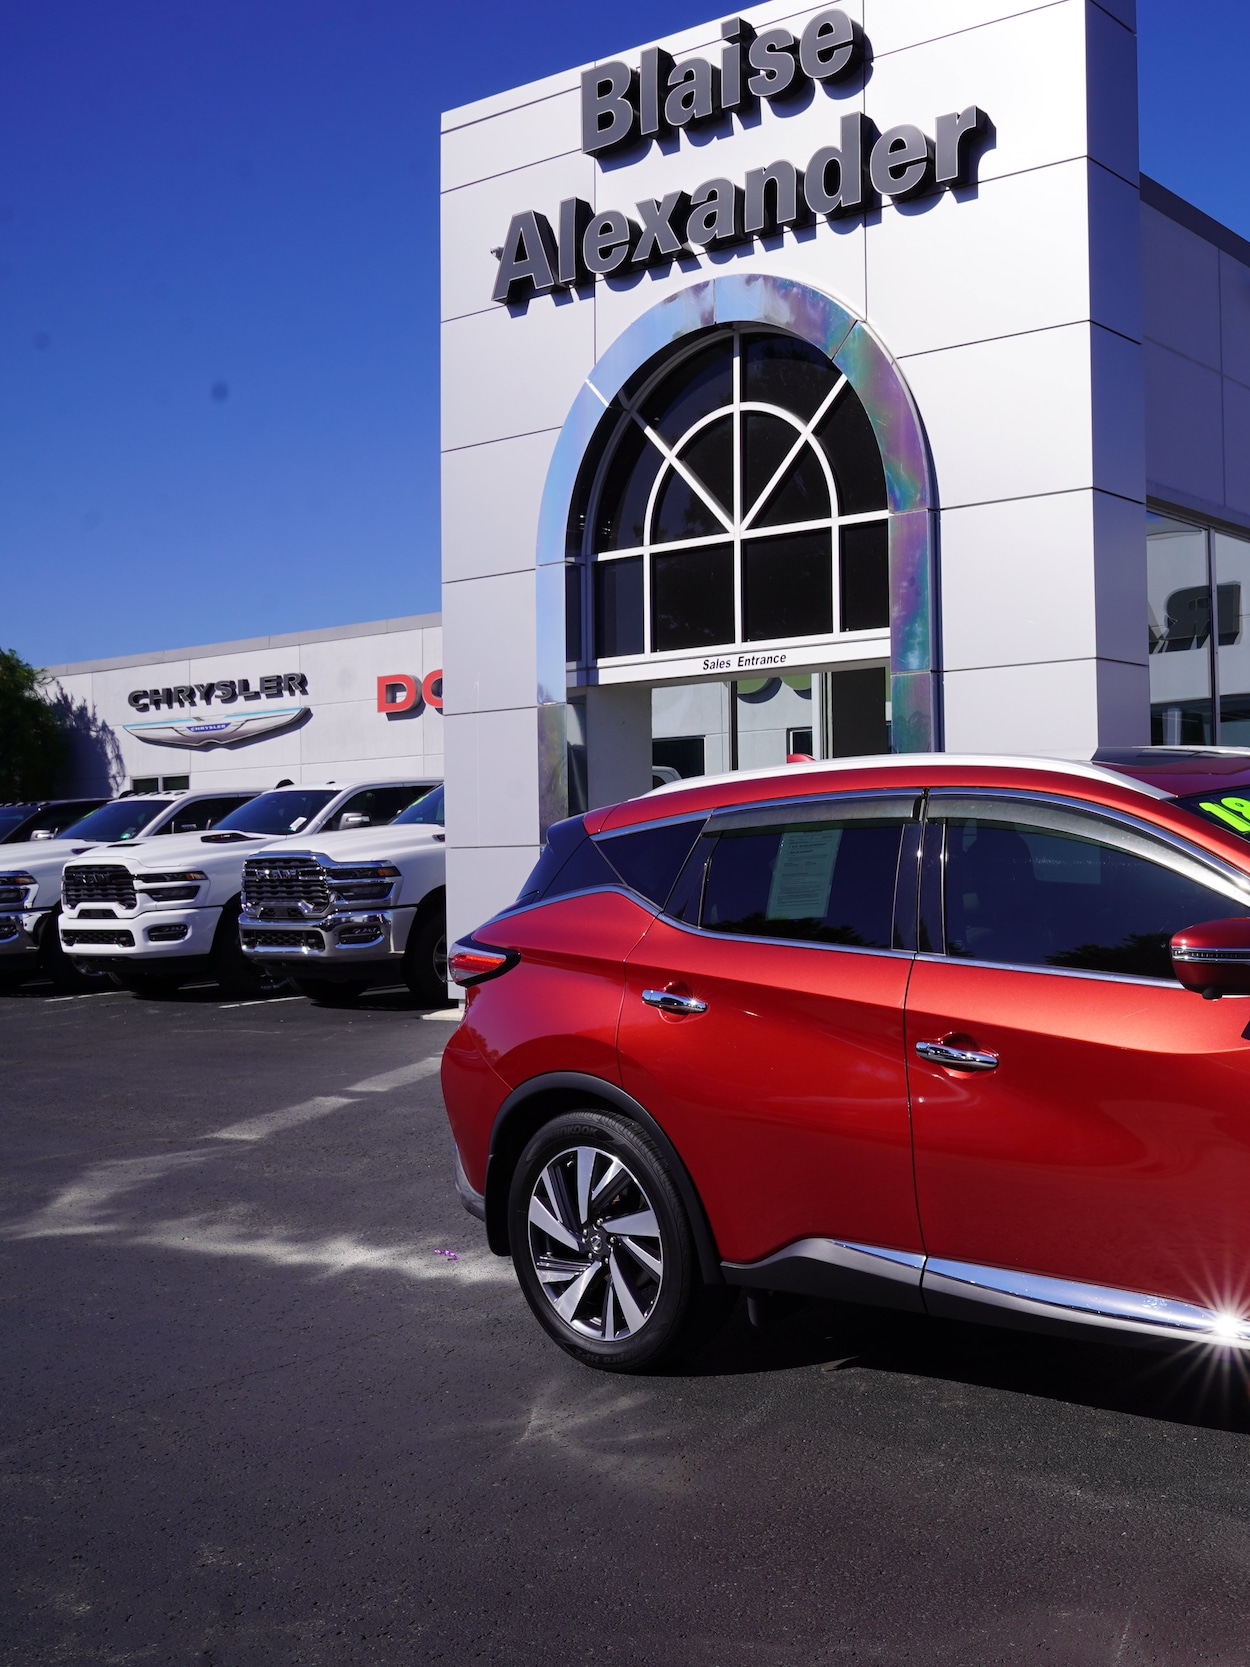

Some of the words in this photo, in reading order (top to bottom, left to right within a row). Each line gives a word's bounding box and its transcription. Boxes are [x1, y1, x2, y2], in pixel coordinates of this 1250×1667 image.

[581, 8, 866, 158] Blaise
[490, 105, 988, 304] Alexander
[128, 672, 308, 710] CHRYSLER
[702, 659, 731, 671] Sales
[737, 653, 787, 668] Entrance
